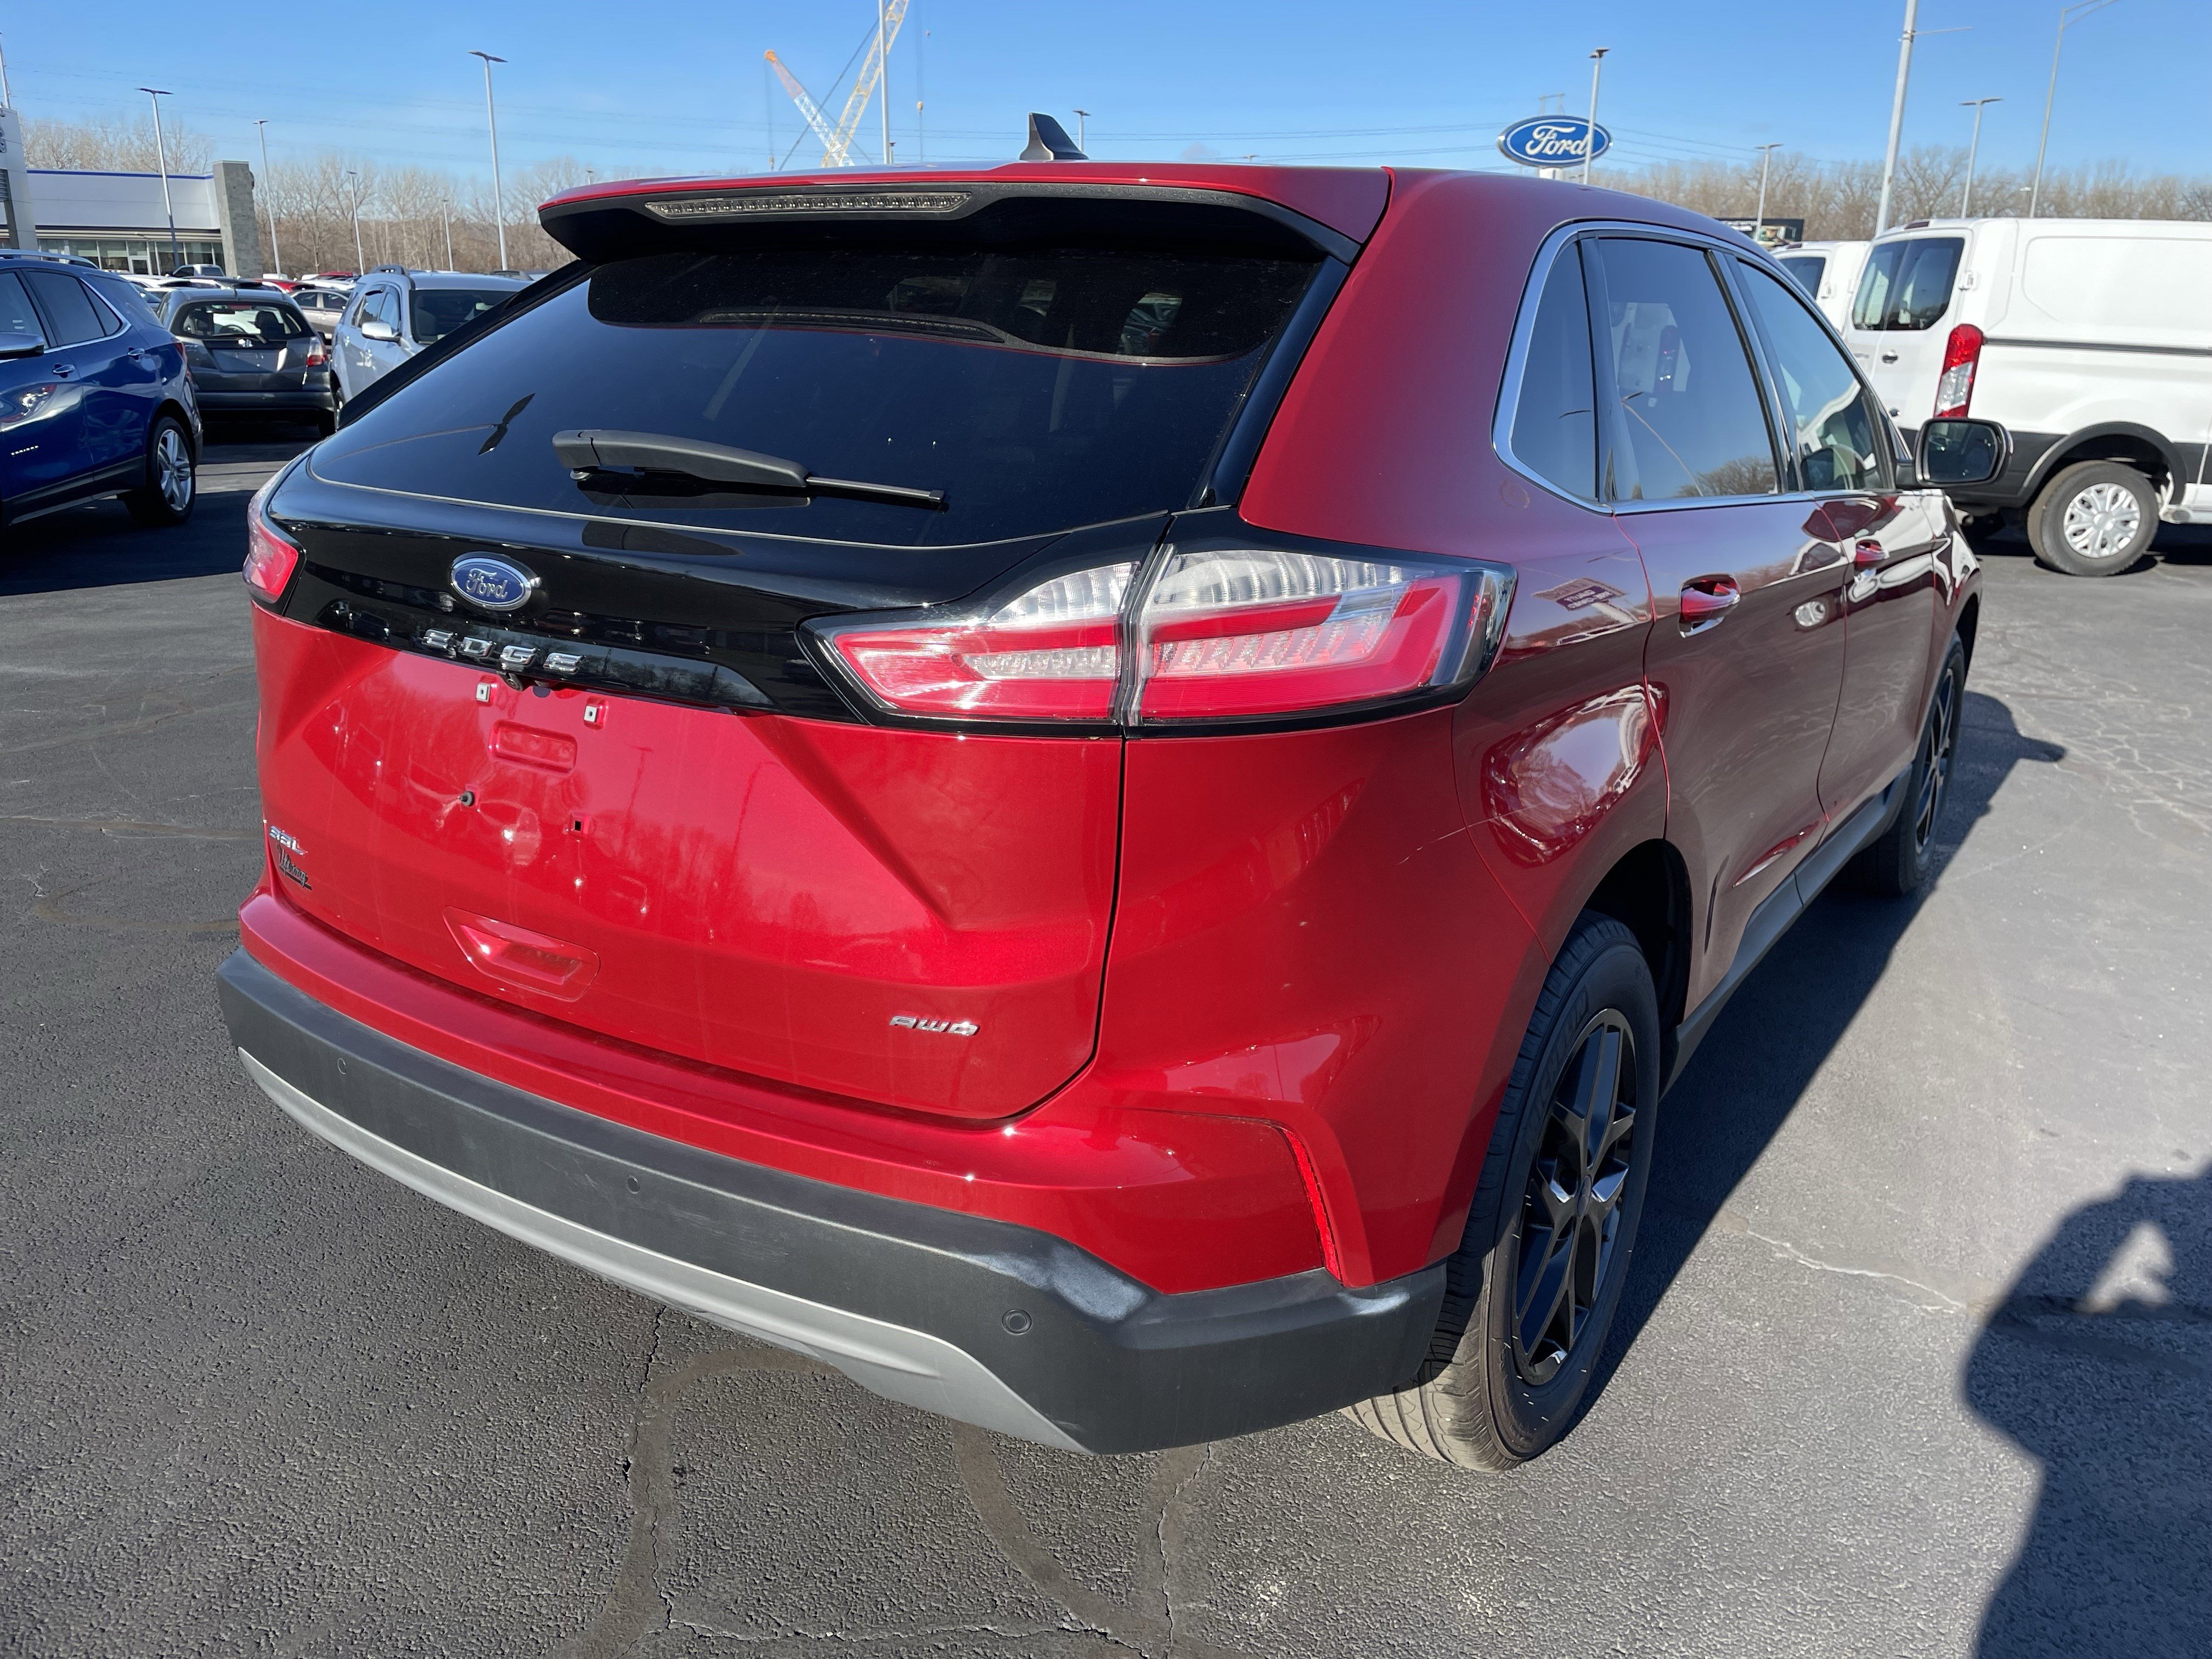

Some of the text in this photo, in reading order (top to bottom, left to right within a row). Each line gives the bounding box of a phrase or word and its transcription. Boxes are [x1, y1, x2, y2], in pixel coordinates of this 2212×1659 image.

[1525, 125, 1589, 155] Ford
[466, 567, 509, 600] Ford
[422, 629, 583, 674] EDGE
[889, 1016, 980, 1036] AWD
